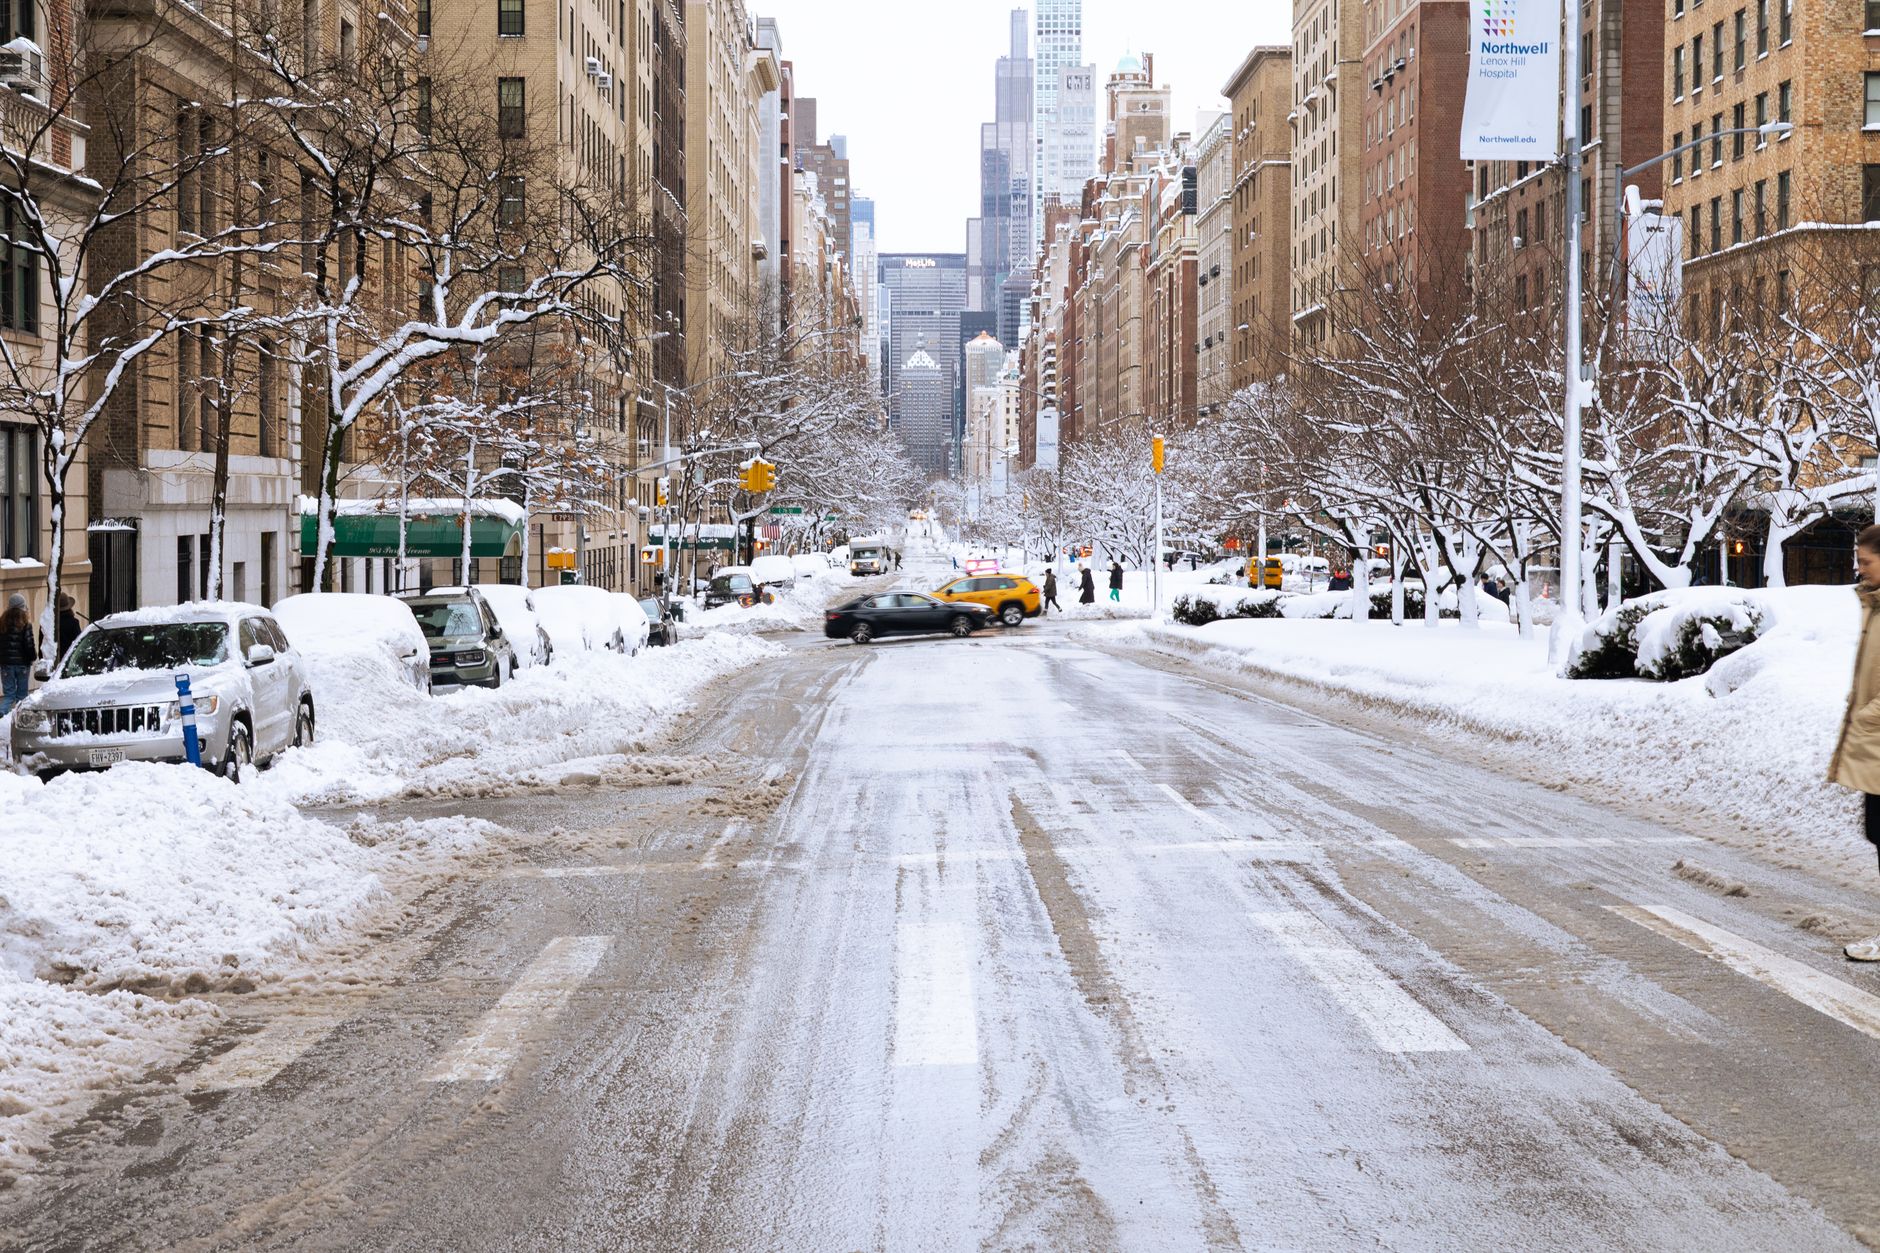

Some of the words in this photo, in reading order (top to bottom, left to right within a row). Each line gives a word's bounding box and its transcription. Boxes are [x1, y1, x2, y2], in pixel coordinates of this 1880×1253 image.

[1481, 42, 1548, 54] Northwell
[1480, 57, 1508, 66] Lenox
[1510, 57, 1526, 66] Hill
[1479, 69, 1518, 79] Hospital
[1479, 135, 1537, 143] Northwell.edu
[905, 258, 936, 267] MetLife
[382, 546, 401, 554] Par
